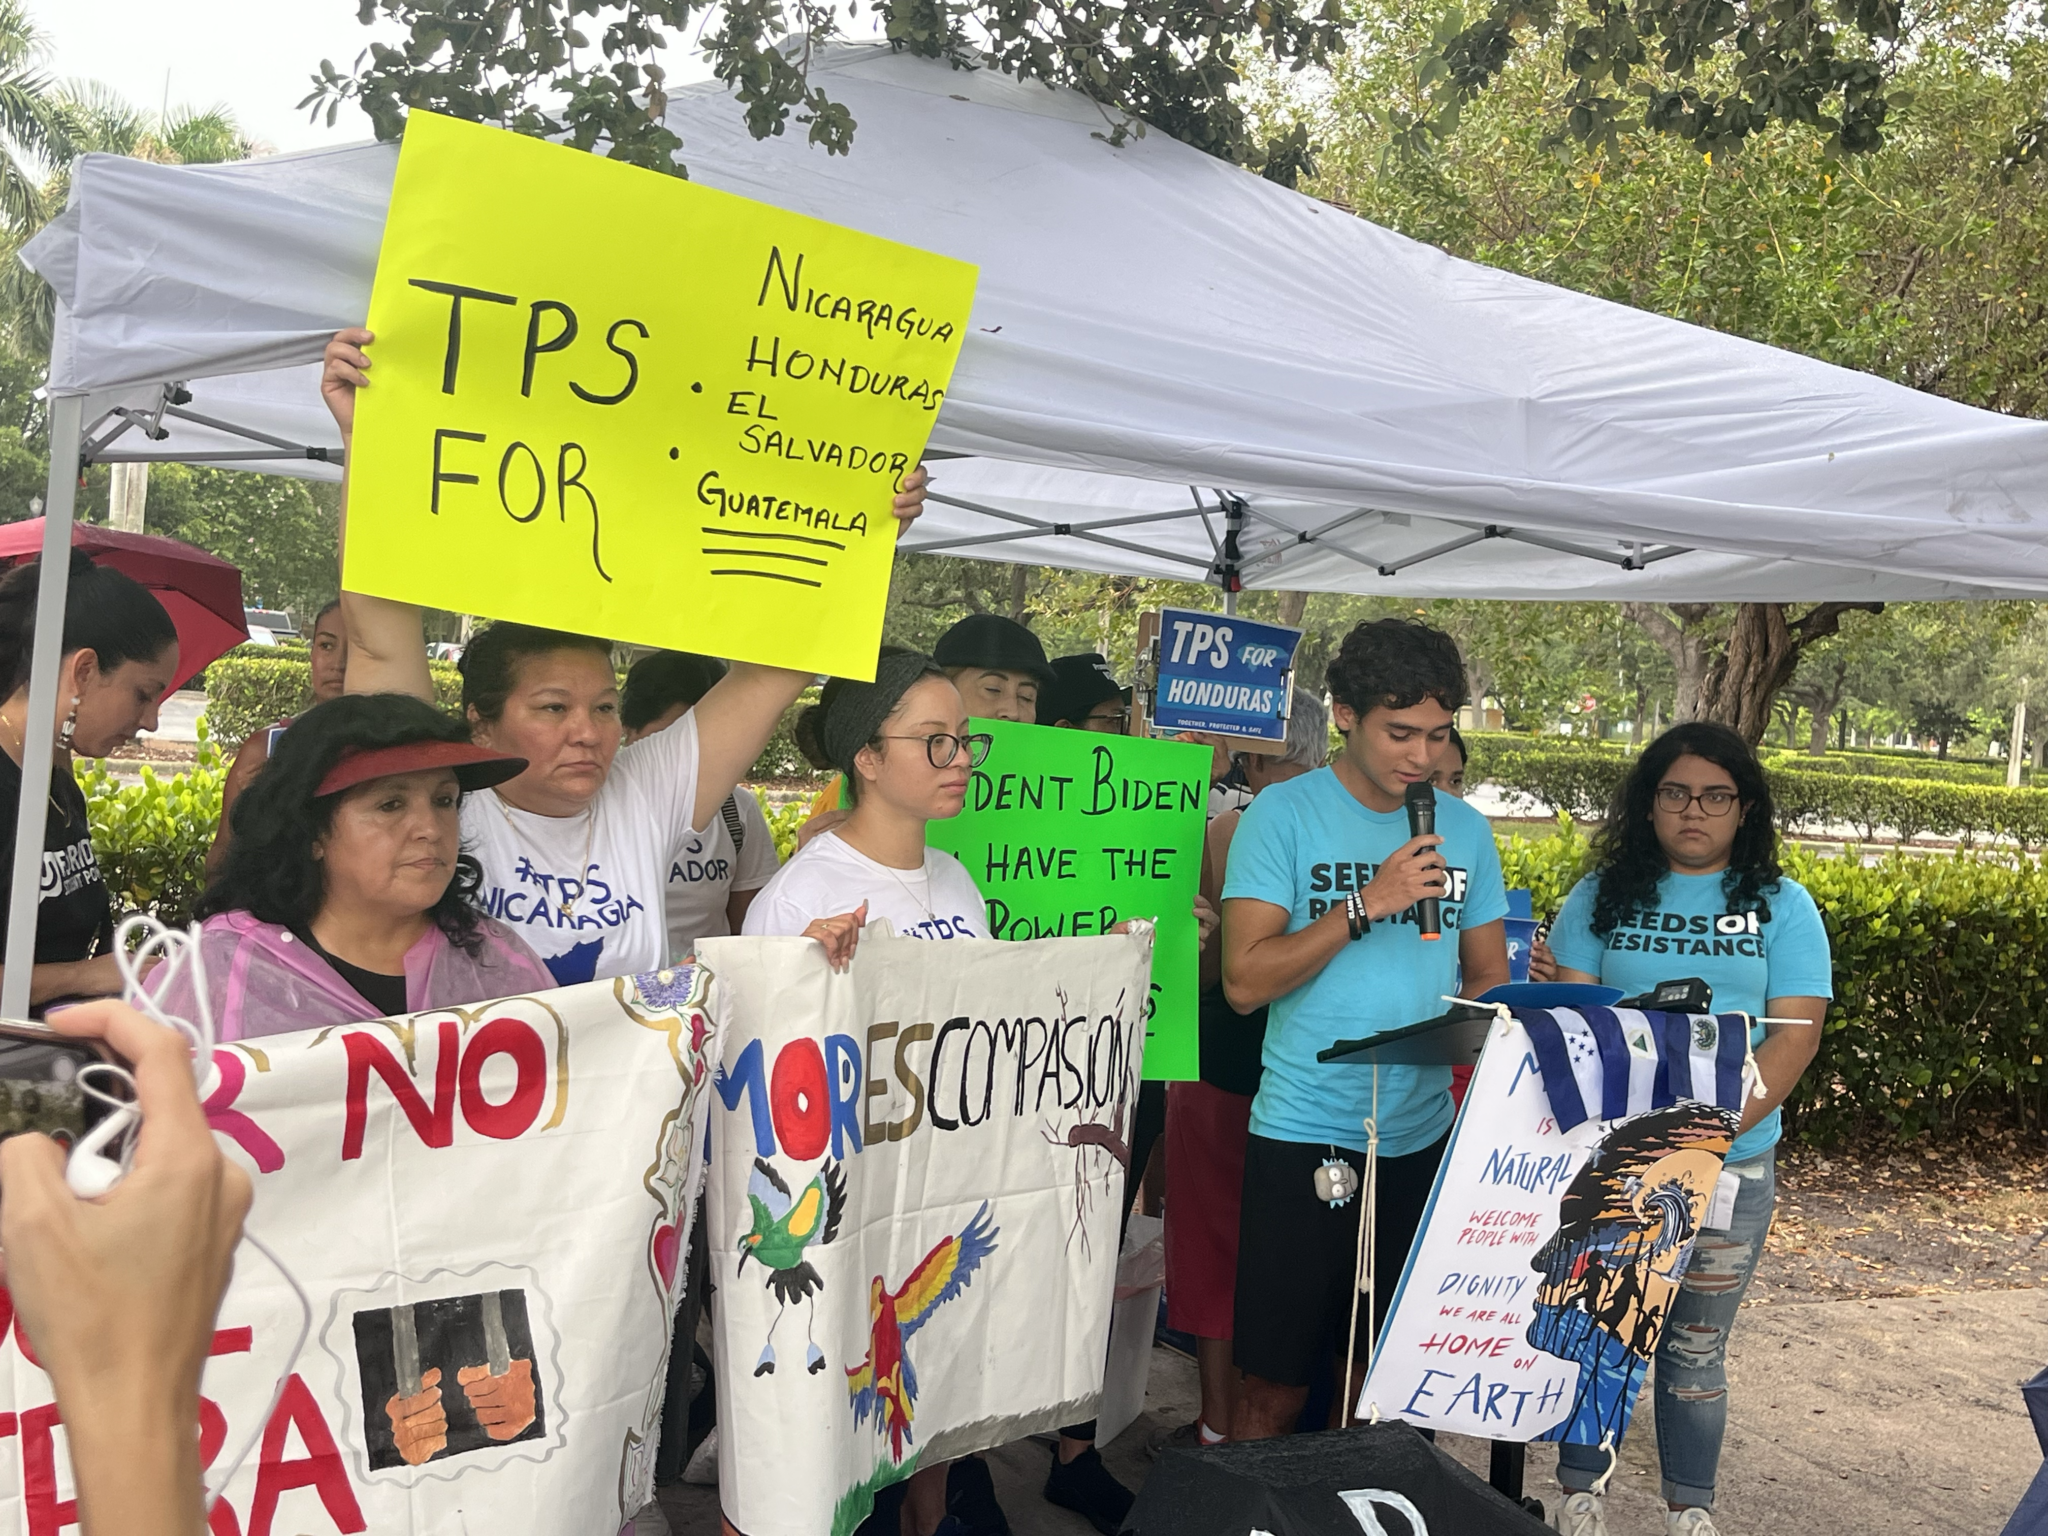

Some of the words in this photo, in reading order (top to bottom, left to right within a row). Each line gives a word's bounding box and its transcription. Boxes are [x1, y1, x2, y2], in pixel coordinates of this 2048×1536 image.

[757, 245, 954, 344] NICARAGUA
[408, 277, 650, 406] TPS
[745, 335, 945, 411] HONDURAS
[726, 391, 778, 421] EL
[738, 423, 910, 495] SALVADOR
[431, 428, 613, 584] FOR
[698, 470, 868, 538] GUATEMALA
[1170, 620, 1233, 669] TPS
[1241, 646, 1277, 668] FOR
[1166, 678, 1274, 714] HONDURAS
[1209, 722, 1240, 732] PROTECTED
[963, 770, 1074, 812] DENT
[1081, 745, 1201, 816] BIDEN
[668, 858, 729, 884] ADOR
[986, 843, 1078, 883] HAVE
[1102, 848, 1177, 881] THE
[1309, 862, 1382, 892] SEE
[1619, 910, 1709, 935] EEDS
[1608, 932, 1766, 959] ESISTANCE
[342, 1018, 547, 1161] NO
[1536, 1117, 1556, 1136] IS
[1479, 1144, 1573, 1195] NATURAL
[1468, 1209, 1543, 1228] WELCOME
[1457, 1227, 1507, 1247] PEOPLE
[1509, 1231, 1540, 1247] WITH
[1437, 1272, 1528, 1304] DIGNITY
[1439, 1305, 1465, 1317] WE
[1466, 1309, 1498, 1322] ARE
[1499, 1312, 1521, 1325] ALL
[1418, 1333, 1515, 1358] HOME
[1513, 1354, 1539, 1371] ON
[1399, 1369, 1566, 1427] EARTH
